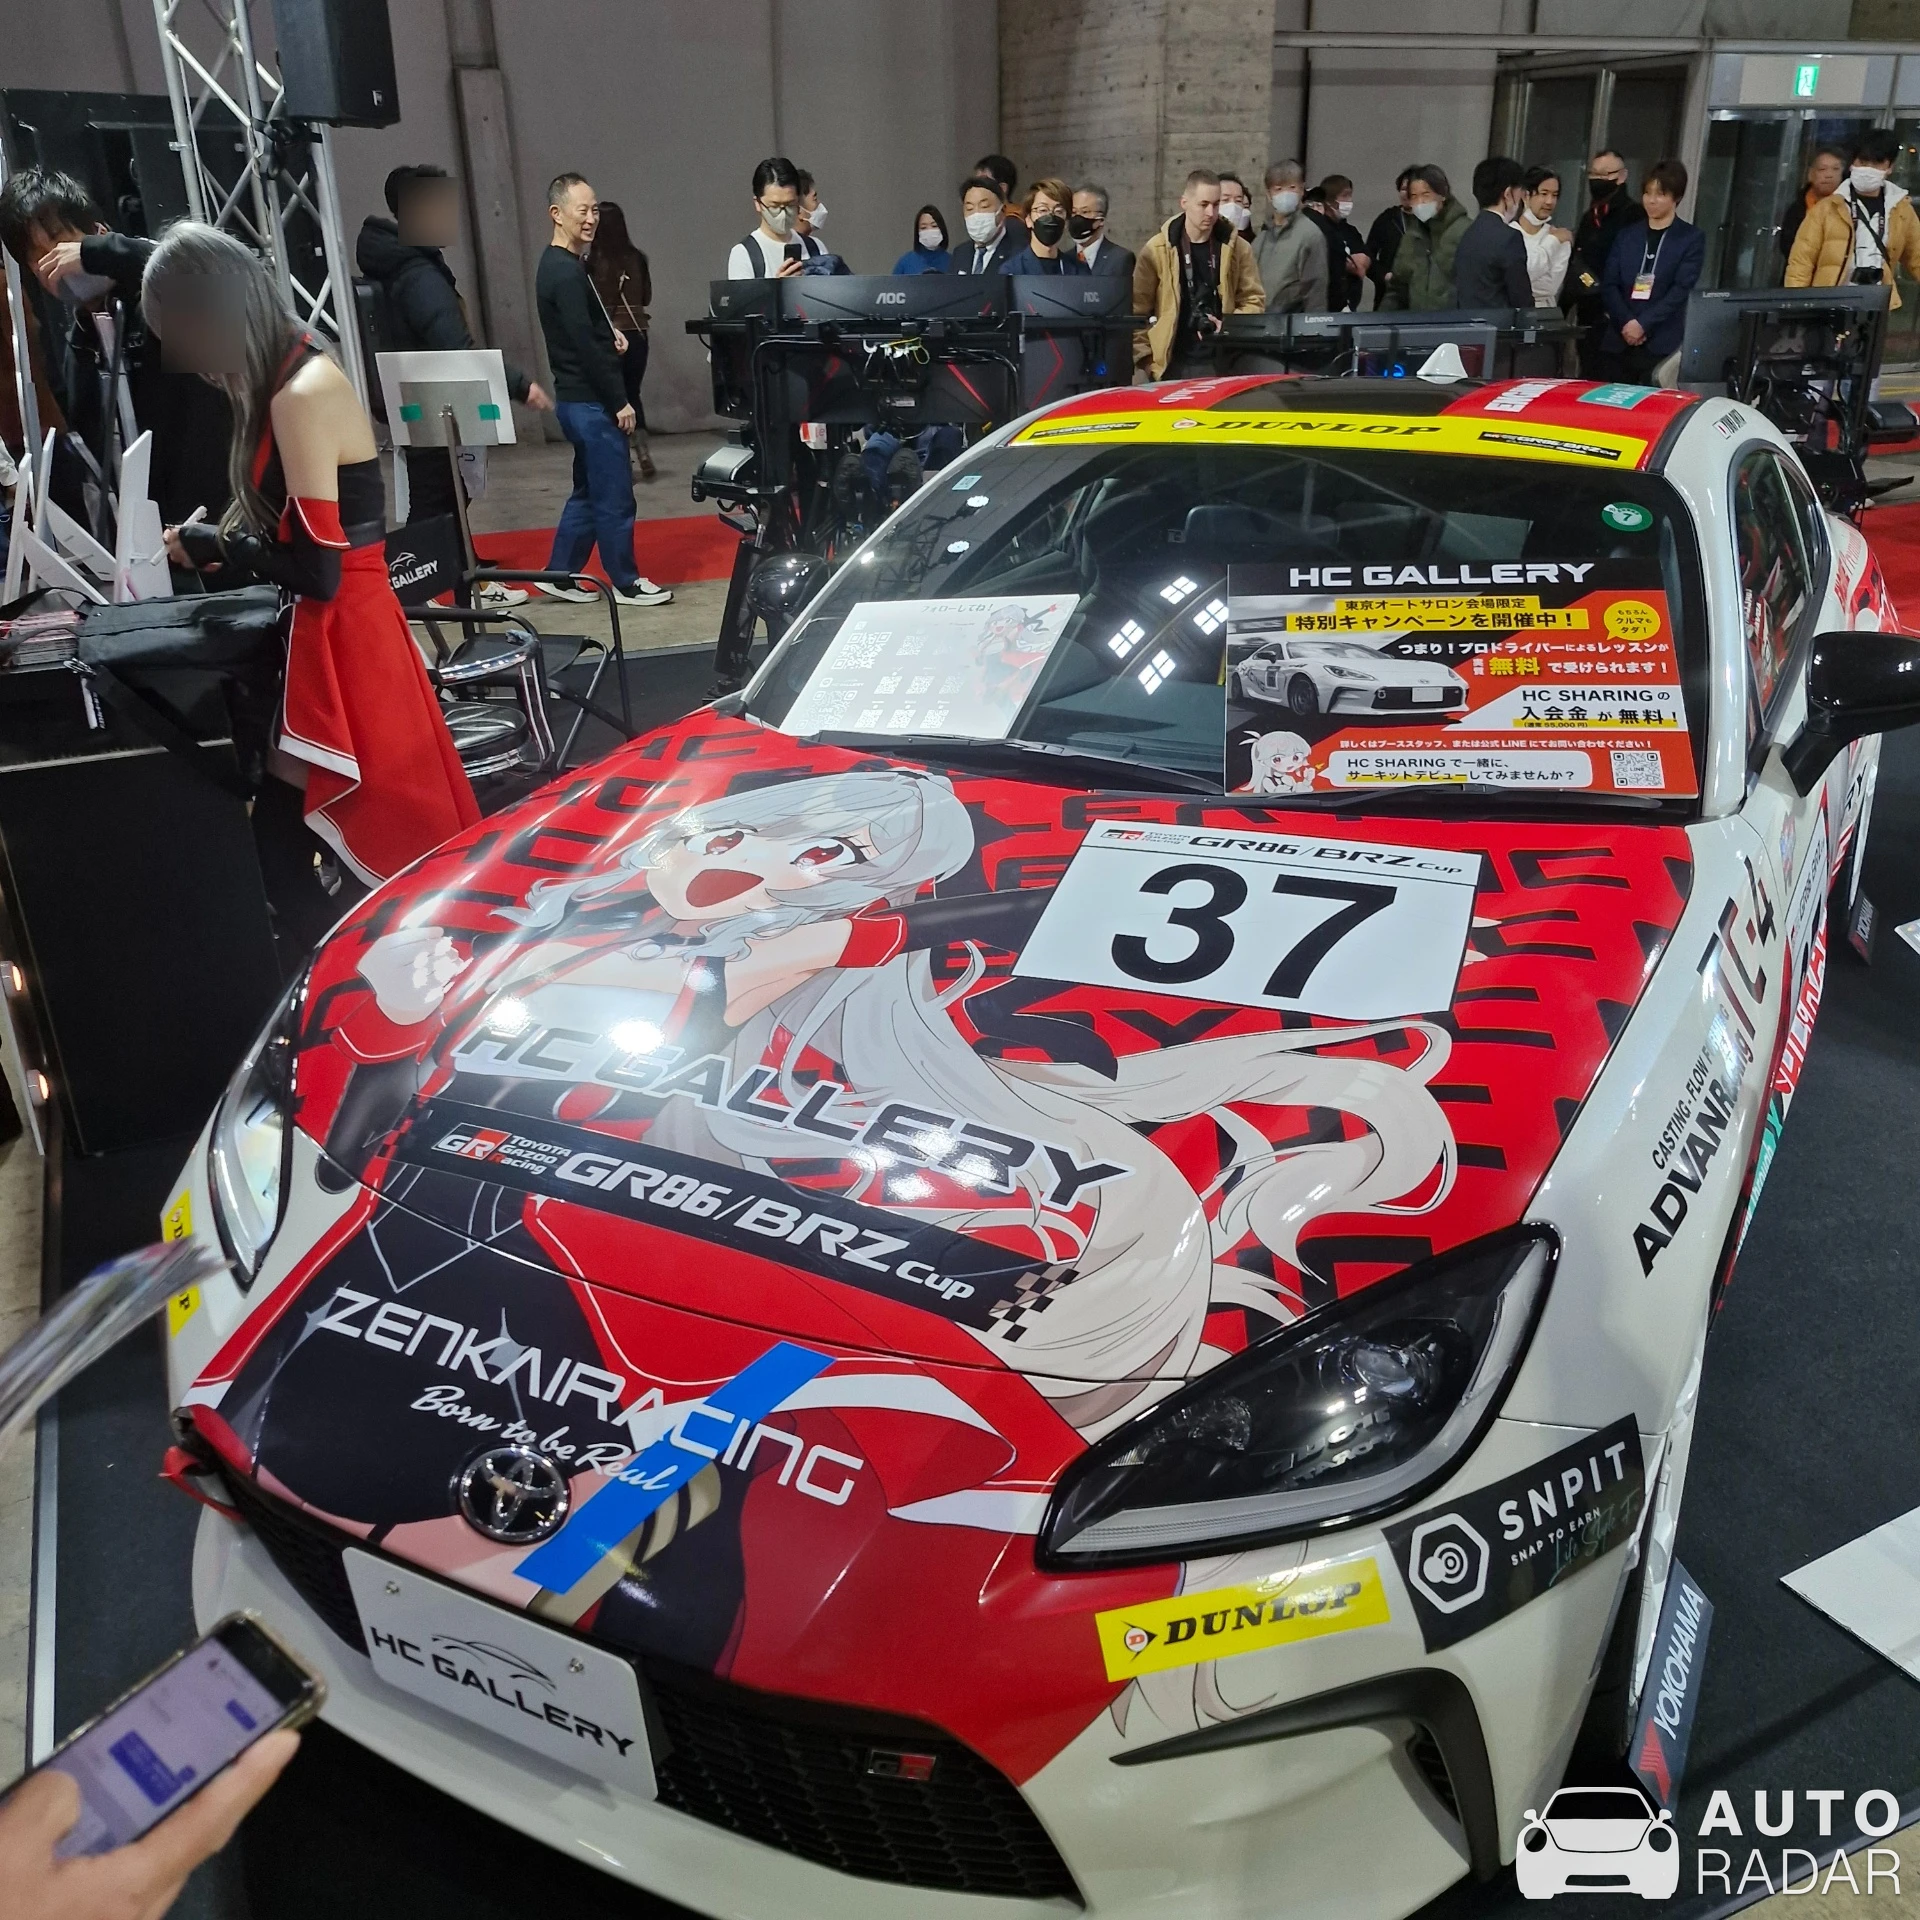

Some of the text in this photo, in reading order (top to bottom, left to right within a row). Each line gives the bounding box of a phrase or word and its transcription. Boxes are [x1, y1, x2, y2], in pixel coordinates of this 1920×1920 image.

[876, 292, 906, 304] AOC
[1304, 315, 1334, 323] Lenovo
[1208, 421, 1441, 436] DUNLOP
[1623, 512, 1632, 522] 7
[391, 560, 438, 590] GALLERY
[1290, 563, 1595, 587] HC GALLERY
[1344, 597, 1526, 612] 東京オートサロン会場限定
[1295, 612, 1573, 631] 特別キャンペーンを開催中！
[1615, 616, 1653, 626] クルマも
[1620, 625, 1648, 635] タダ！
[1488, 656, 1541, 677] 無料
[1547, 661, 1669, 675] で受けられます！
[1522, 689, 1671, 702] HC SHARING の
[1501, 739, 1526, 748] LINE
[1347, 758, 1369, 768] HC
[1375, 758, 1446, 768] SHARING
[1347, 769, 1575, 782] サーキットデビューしてみませんか？
[1102, 829, 1142, 842] GR
[1416, 862, 1463, 875] Cup
[1111, 862, 1398, 1000] 37
[451, 1021, 1135, 1212] HC GALLERY
[437, 1134, 573, 1158] GR TOYOTA
[1652, 1100, 1691, 1172] CASTING
[487, 1152, 548, 1175] Racing
[498, 1144, 558, 1164] GAZOO
[905, 1256, 976, 1301] Cup
[410, 1384, 677, 1492] Born to be Real
[1498, 1440, 1626, 1541] SNPIT
[1511, 1506, 1602, 1567] SNAP TO EARN
[1163, 1581, 1362, 1646] DUNLOP
[1650, 1580, 1705, 1741] YOKOHAMA
[370, 1626, 635, 1757] HC GALLERY
